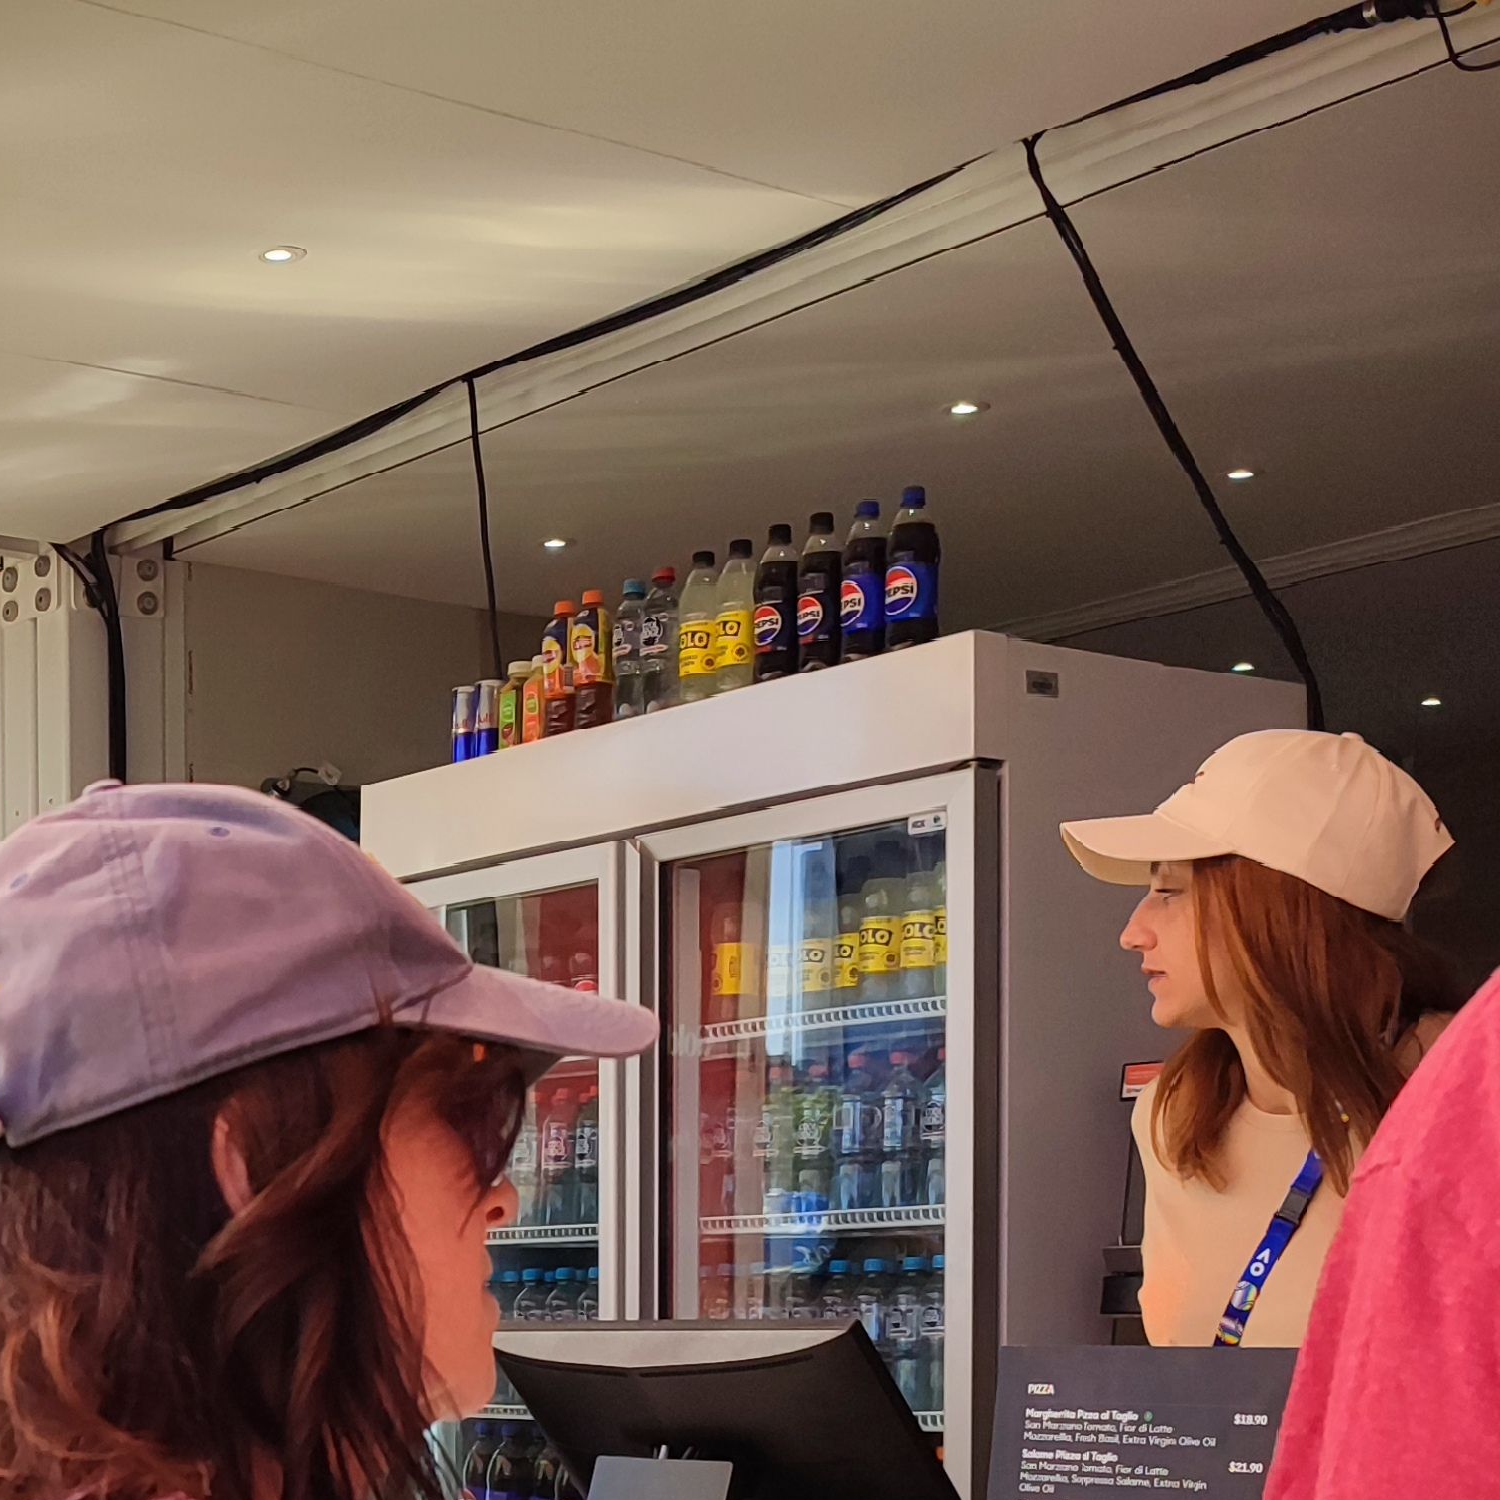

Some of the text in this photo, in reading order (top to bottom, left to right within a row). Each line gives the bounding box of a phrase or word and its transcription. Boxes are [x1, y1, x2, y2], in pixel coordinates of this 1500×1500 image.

[1028, 1383, 1055, 1395] PIZZA
[1111, 1410, 1139, 1423] Taglio
[1233, 1413, 1268, 1425] $18.90
[1138, 1423, 1148, 1433] di
[1122, 1435, 1147, 1445] Extra
[1148, 1436, 1177, 1448] Virgin
[1202, 1437, 1217, 1447] Oil
[1091, 1451, 1118, 1464] Taglio
[1134, 1465, 1143, 1475] di
[1228, 1461, 1264, 1473] $21.90
[1042, 1483, 1055, 1493] Oil
